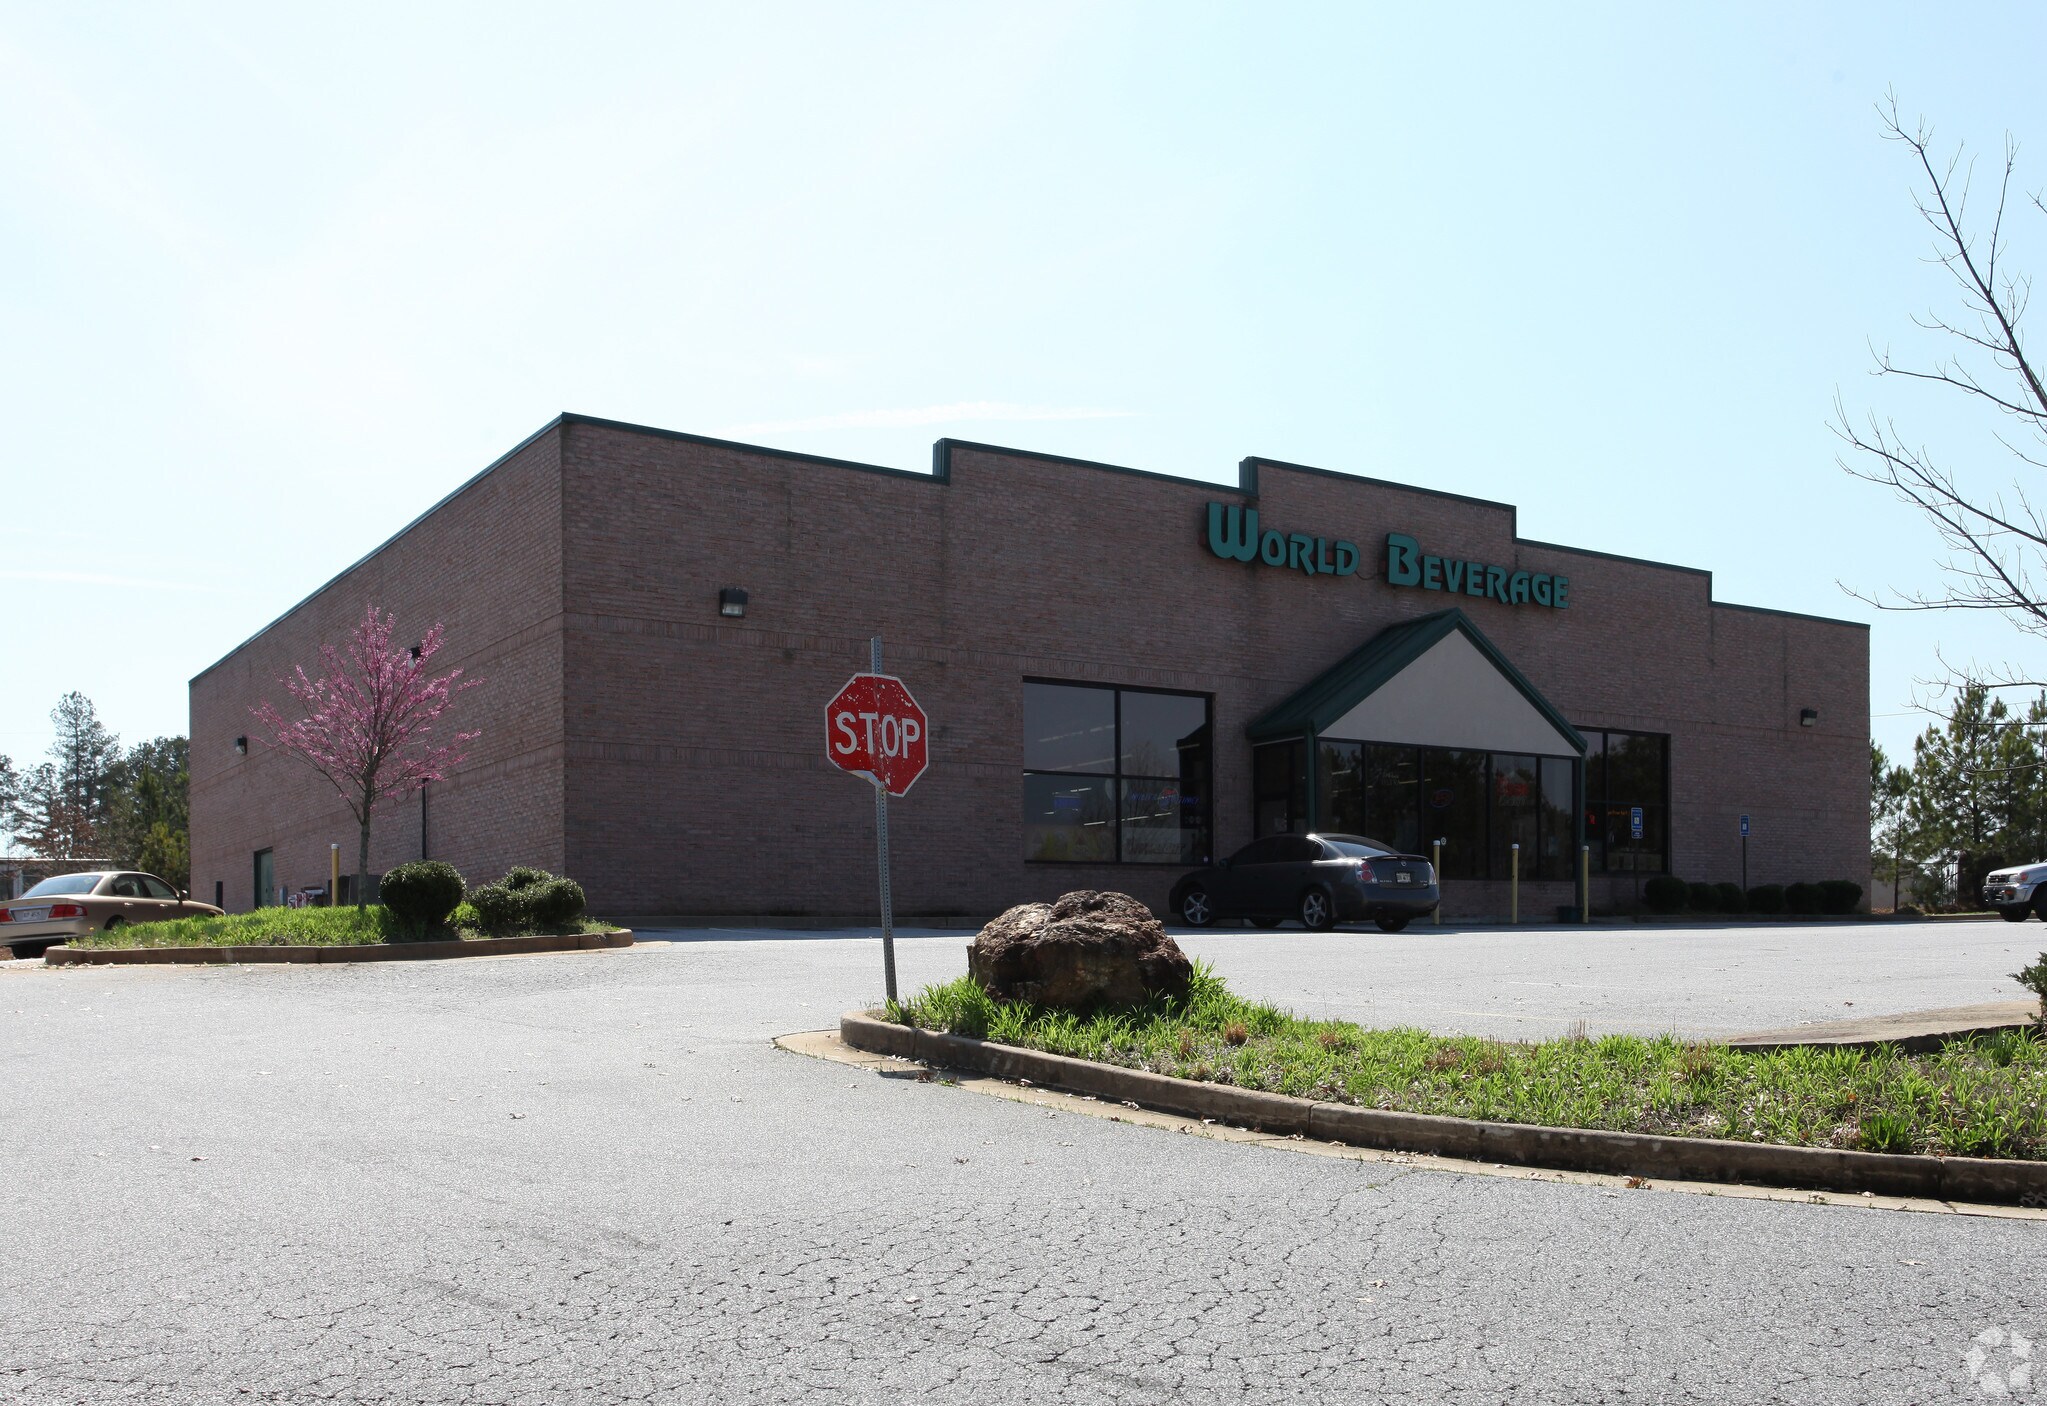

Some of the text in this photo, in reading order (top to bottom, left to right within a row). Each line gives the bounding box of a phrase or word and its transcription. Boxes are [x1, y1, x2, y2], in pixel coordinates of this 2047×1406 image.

[1206, 502, 1570, 609] WORLD BEVERAGE
[835, 711, 921, 760] STOP
